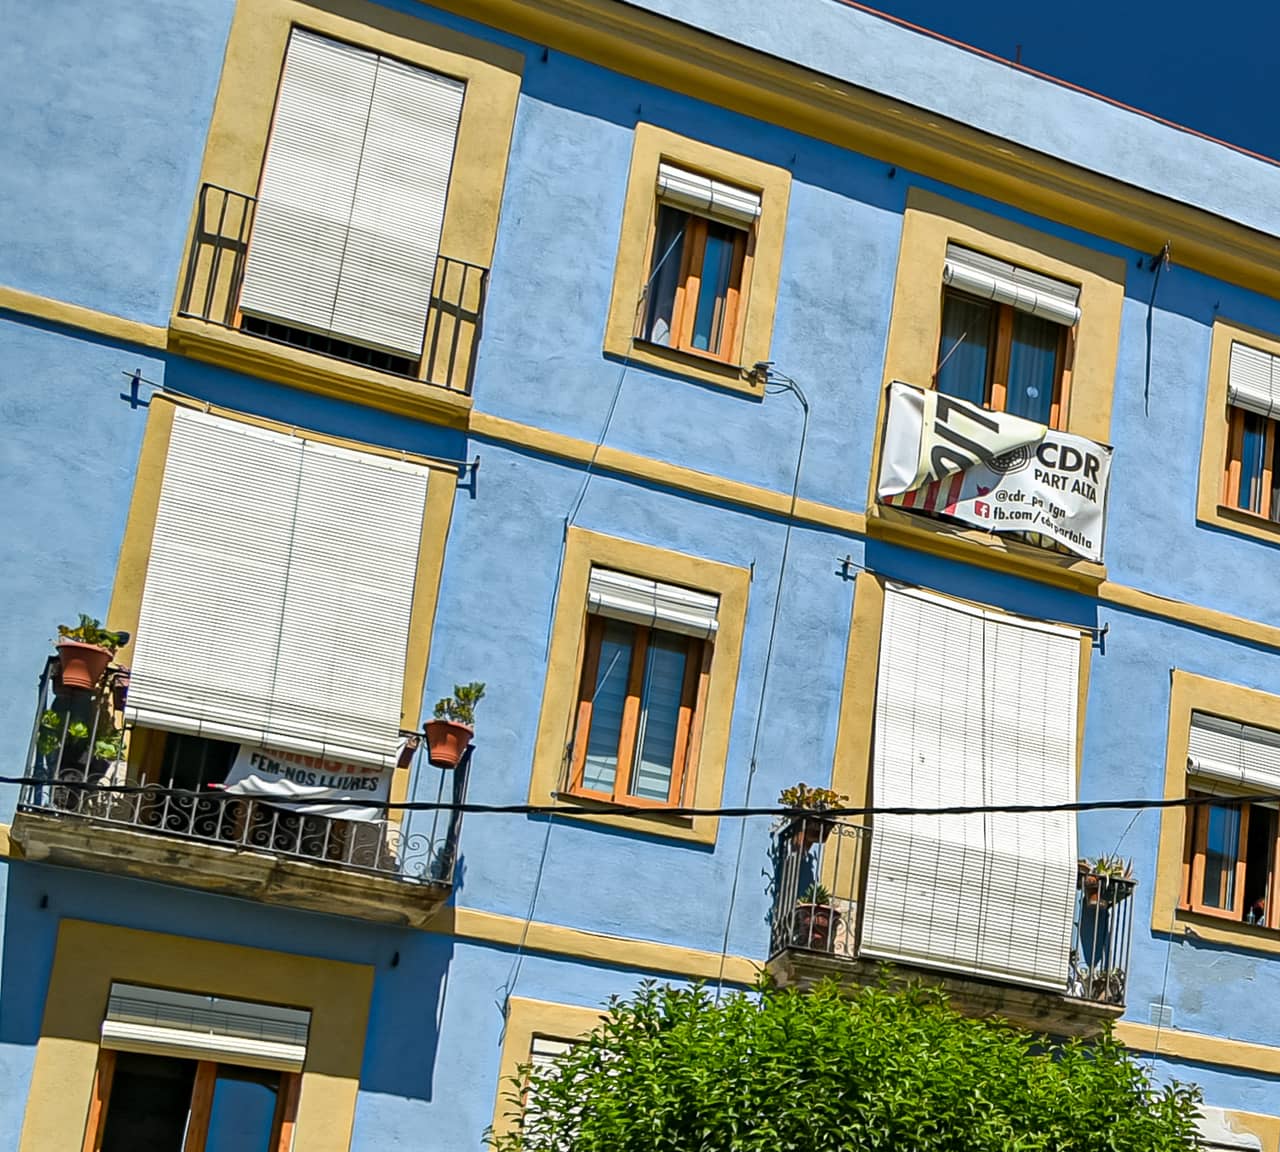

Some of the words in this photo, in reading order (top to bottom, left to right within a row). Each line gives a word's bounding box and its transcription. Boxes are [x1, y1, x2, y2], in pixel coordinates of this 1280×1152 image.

[1036, 442, 1100, 484] CDR
[1034, 469, 1069, 491] PART
[1071, 480, 1097, 503] ALTA
[250, 752, 316, 786] FEM-NOS
